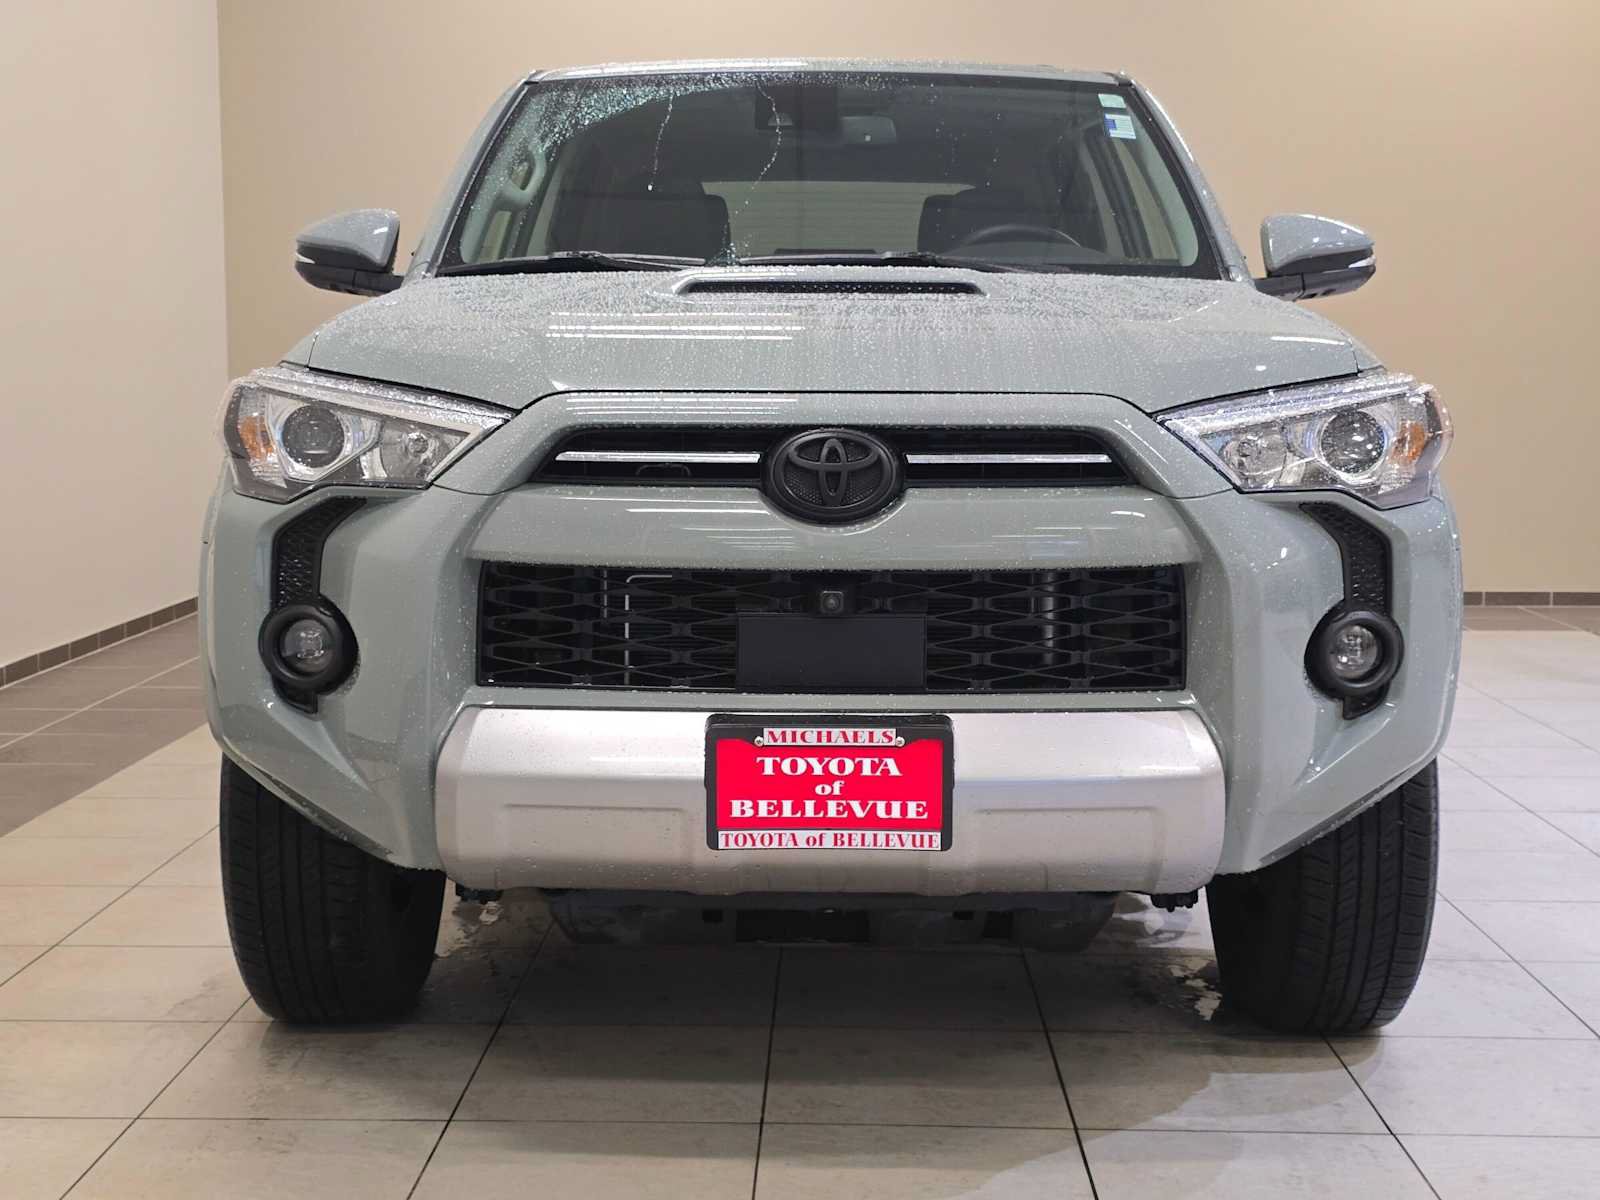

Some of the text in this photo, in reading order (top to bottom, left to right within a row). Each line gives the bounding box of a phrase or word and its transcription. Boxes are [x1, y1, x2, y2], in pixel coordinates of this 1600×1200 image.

[767, 730, 893, 744] MICHAELS
[756, 757, 903, 776] TOYOTA
[815, 781, 845, 796] of
[729, 800, 928, 819] BELLEVUE
[720, 832, 940, 849] TOYOTA of BELLEVUE
